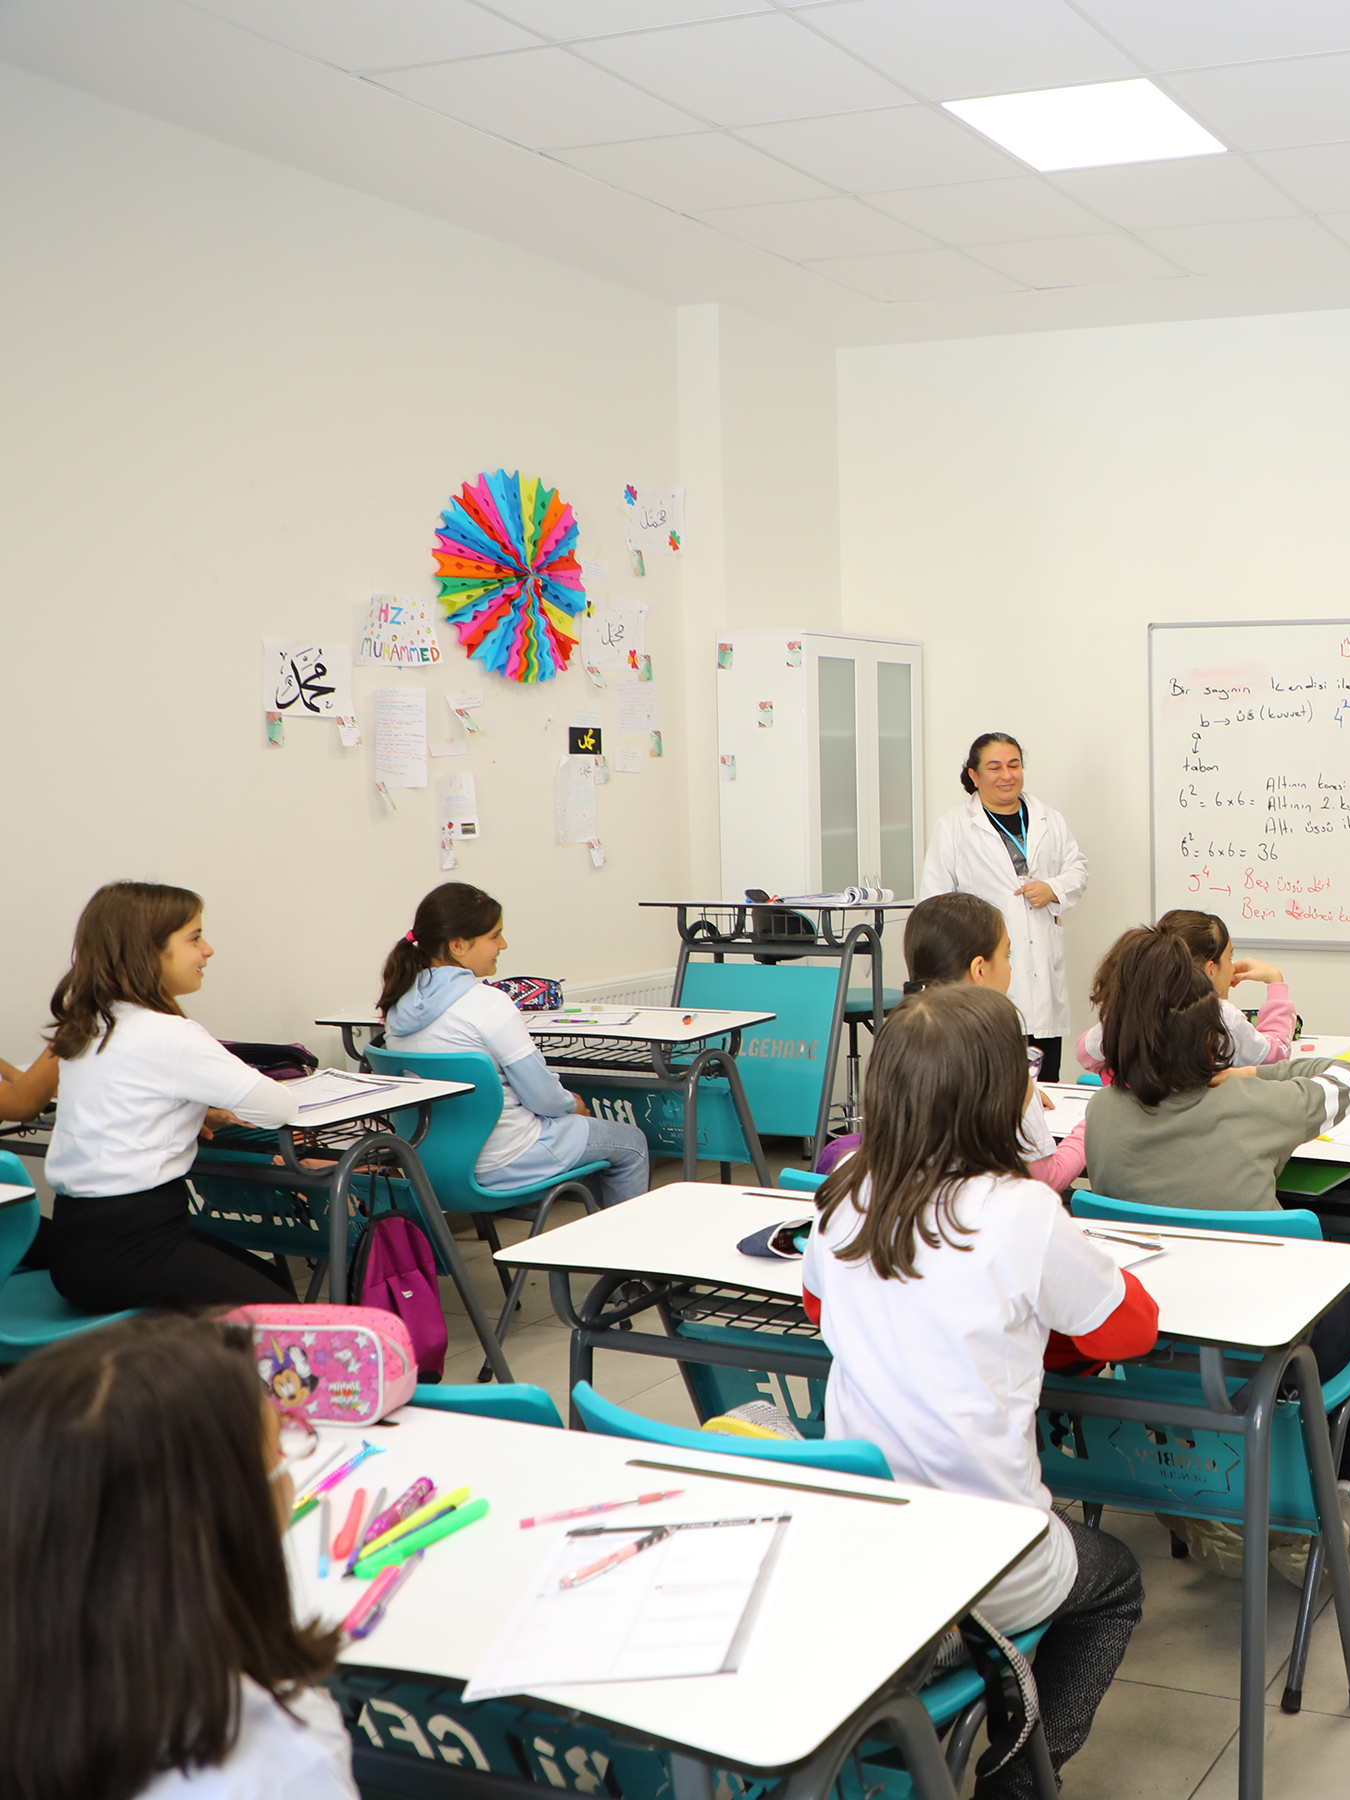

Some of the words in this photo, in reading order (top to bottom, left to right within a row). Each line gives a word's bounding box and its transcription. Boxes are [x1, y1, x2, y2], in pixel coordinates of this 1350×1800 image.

[360, 637, 441, 662] MUHAMMED
[1169, 677, 1191, 697] Bir
[1182, 756, 1219, 772] taban
